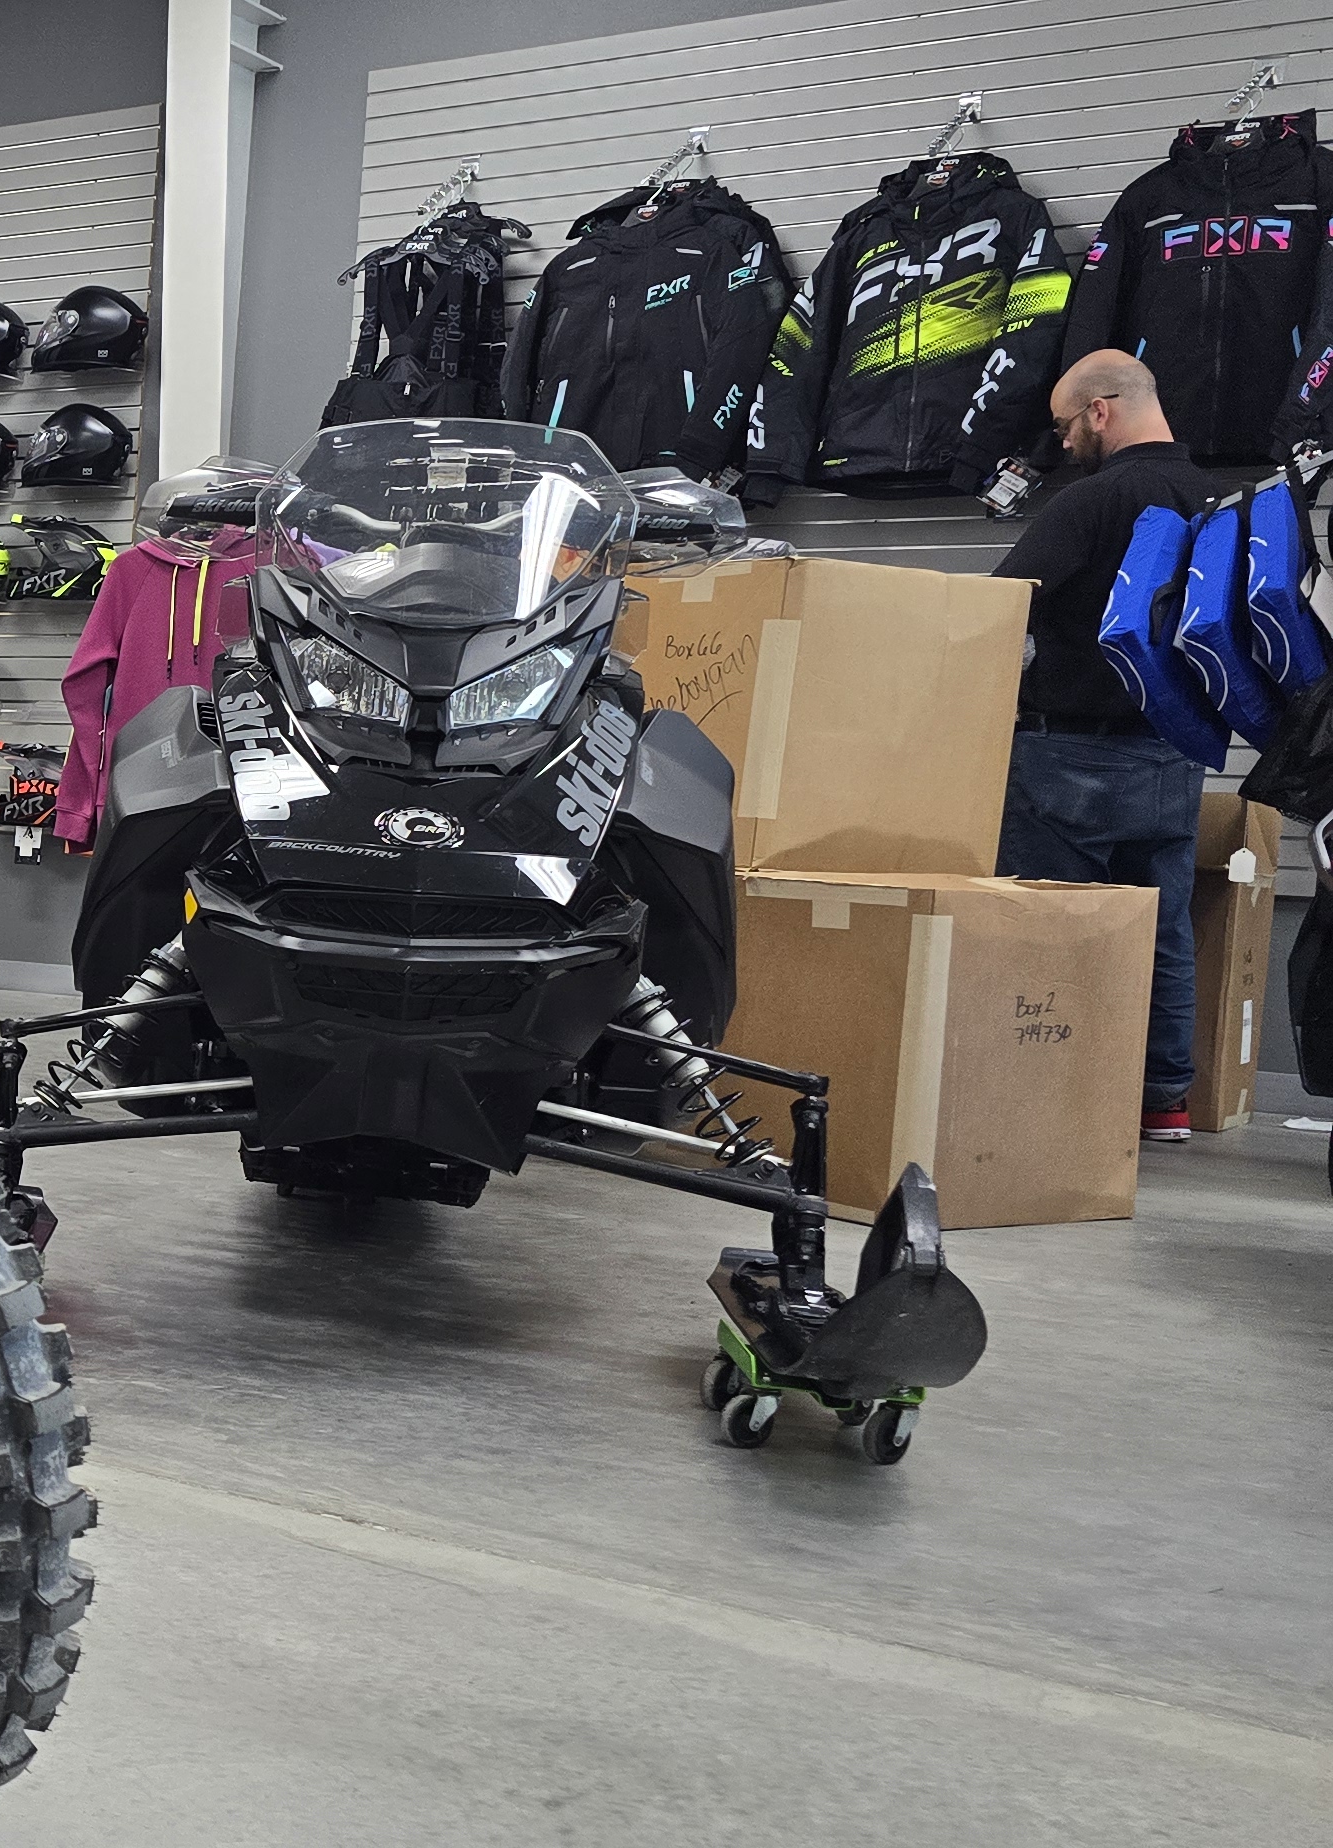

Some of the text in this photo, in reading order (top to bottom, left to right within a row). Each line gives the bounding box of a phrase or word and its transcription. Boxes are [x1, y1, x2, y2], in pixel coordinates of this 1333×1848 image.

[406, 242, 430, 251] FXR
[1164, 217, 1293, 261] FXR
[847, 218, 1002, 326] FXR
[646, 274, 691, 302] FXR
[1007, 318, 1035, 333] DIV
[962, 348, 1016, 435] FXR
[713, 384, 744, 430] FXR
[22, 568, 67, 593] FXR
[4, 795, 44, 822] FXR
[413, 823, 449, 835] BRP
[266, 841, 402, 860] BACKCOUNTRY
